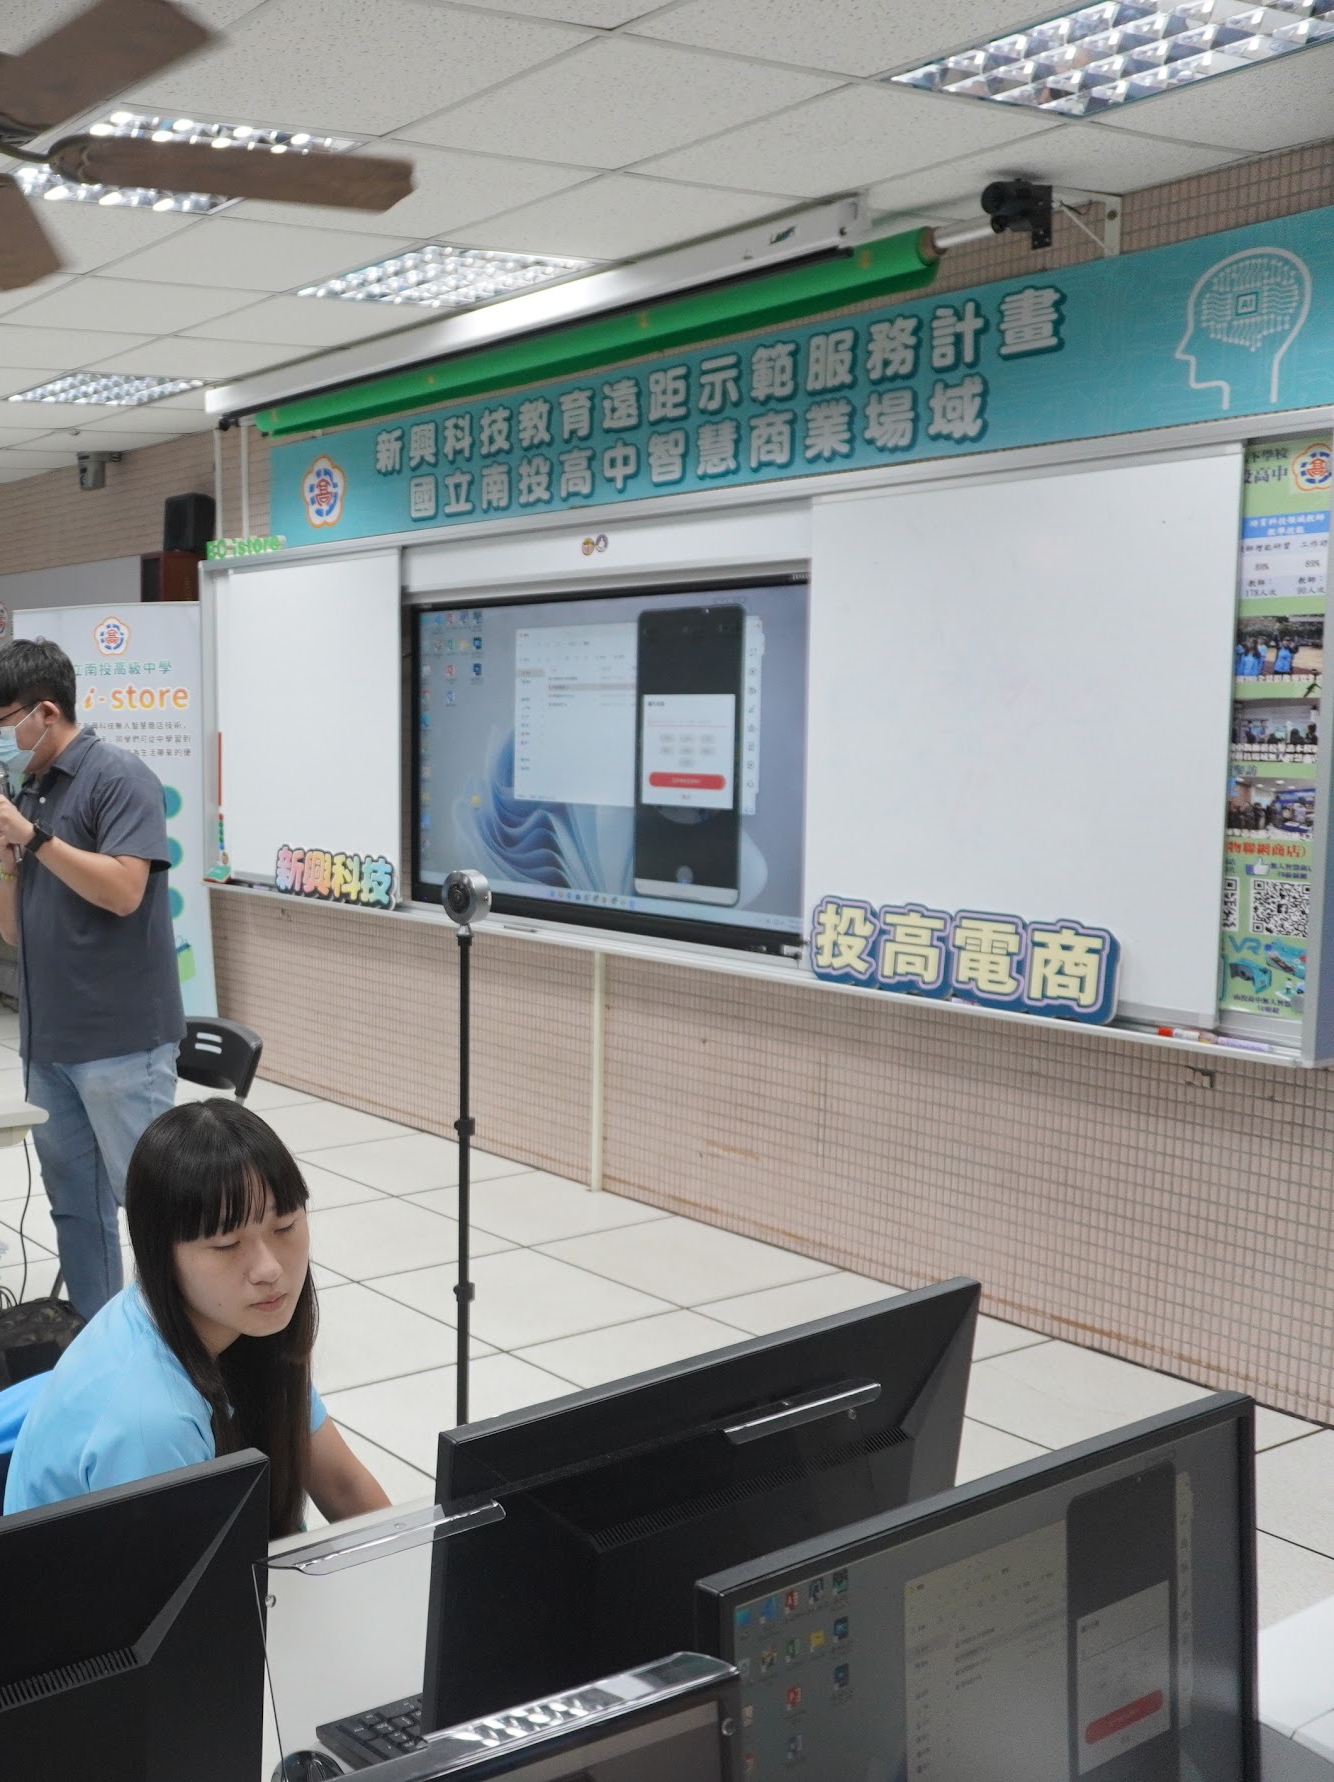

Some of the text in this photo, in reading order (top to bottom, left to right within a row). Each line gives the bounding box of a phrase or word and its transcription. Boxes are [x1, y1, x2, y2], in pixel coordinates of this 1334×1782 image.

[375, 287, 1062, 474] 新興科技教育遠距示範服務計畫
[409, 374, 986, 520] 國立南投高中智慧商業場域
[275, 845, 395, 906] 新興科技
[813, 900, 1108, 1008] 投高電商
